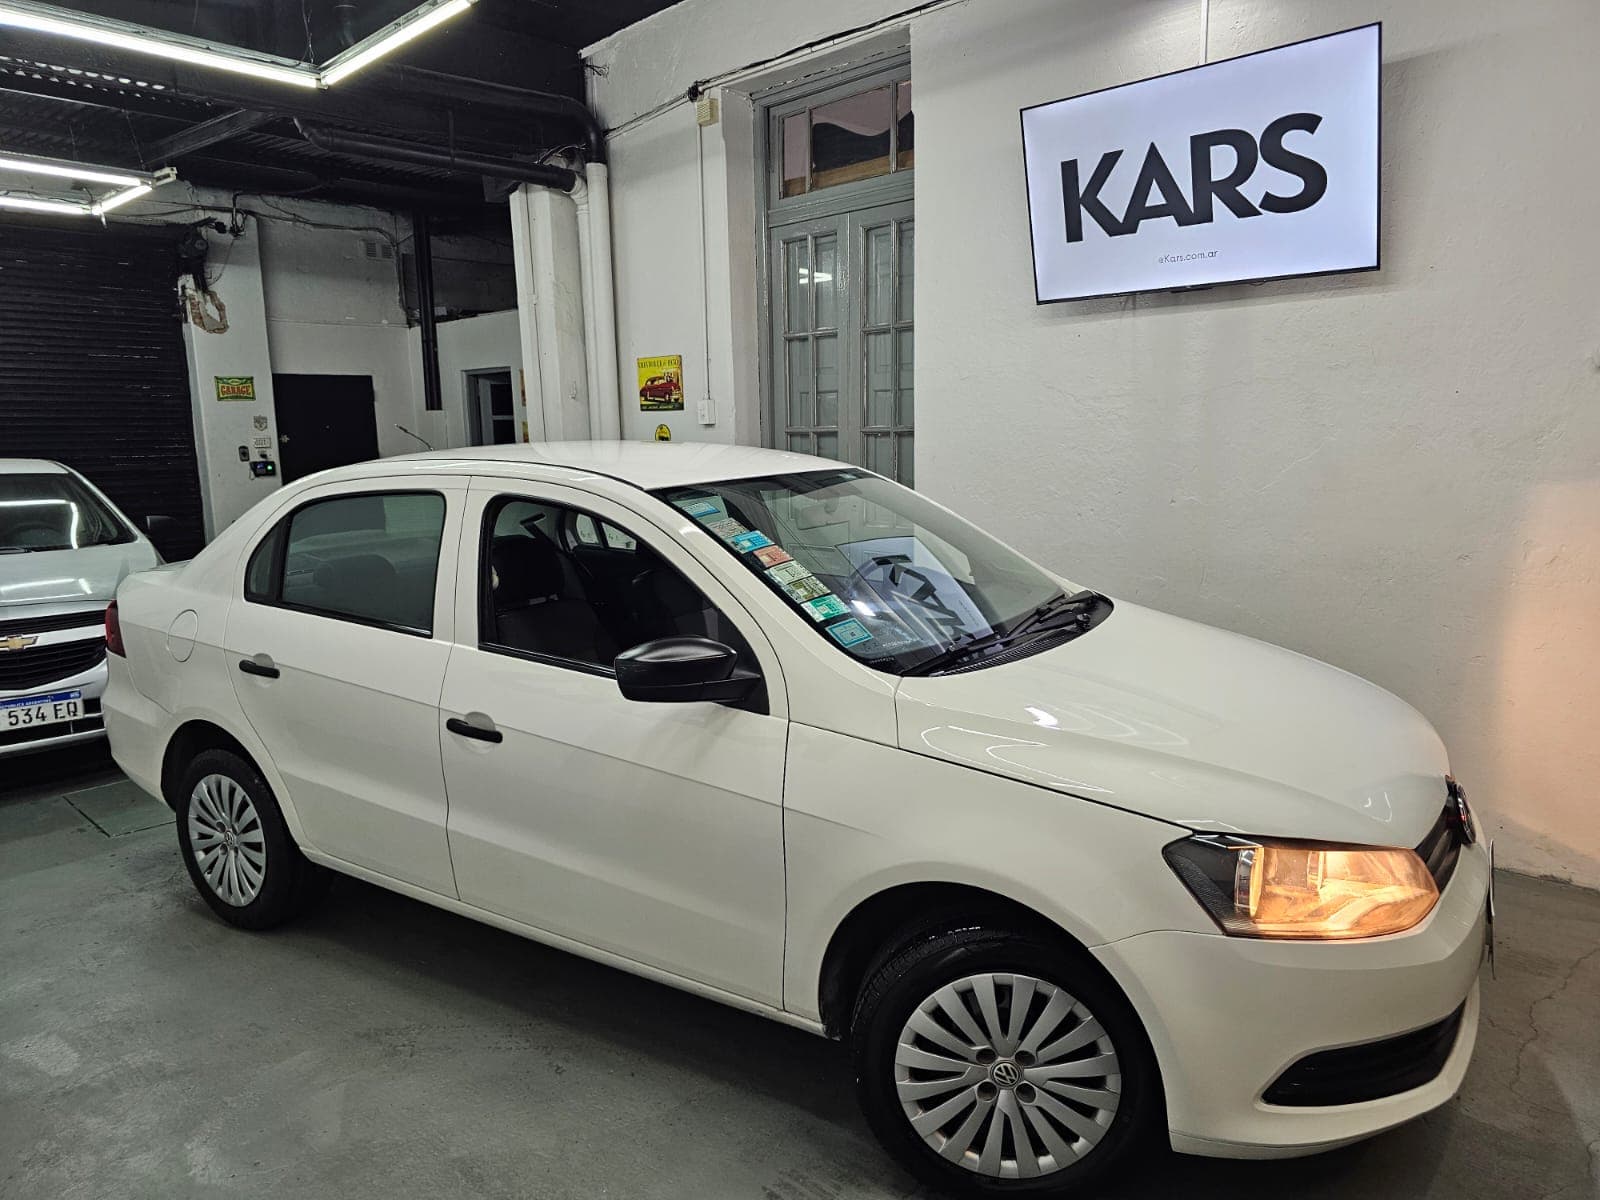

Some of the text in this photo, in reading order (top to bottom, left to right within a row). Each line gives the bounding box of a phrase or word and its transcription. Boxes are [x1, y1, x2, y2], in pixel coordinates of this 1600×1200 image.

[1060, 112, 1328, 243] KARS
[1158, 250, 1219, 264] eKars.com.ar
[8, 702, 78, 726] 534 EQ
